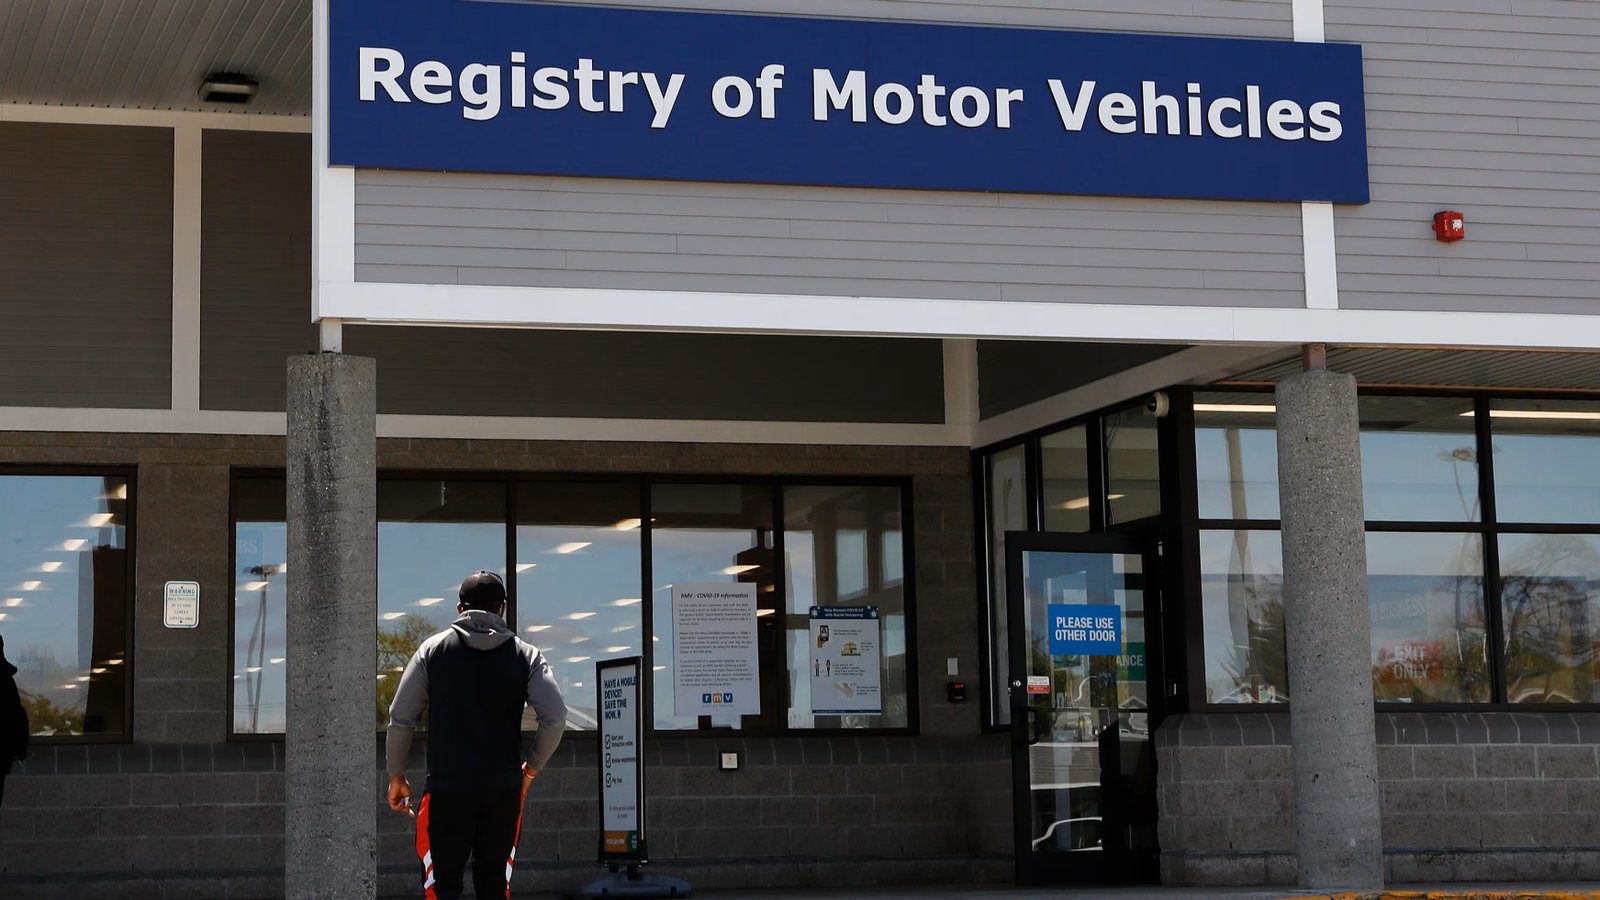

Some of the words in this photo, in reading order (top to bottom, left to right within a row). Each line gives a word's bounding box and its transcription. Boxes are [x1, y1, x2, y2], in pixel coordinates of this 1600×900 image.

[360, 47, 685, 128] Registry
[712, 65, 784, 118] of
[814, 69, 1023, 127] Motor
[1048, 79, 1342, 141] Vehicles
[720, 592, 749, 600] Information
[1056, 616, 1093, 629] PLEASE
[1095, 617, 1114, 629] USE
[1055, 629, 1087, 641] OTHER
[1089, 630, 1116, 642] DOOR
[1394, 645, 1426, 661] EXIT
[1393, 664, 1430, 680] ONLY
[604, 679, 616, 689] HAVE
[616, 678, 621, 687] A
[604, 689, 623, 700] DEVICE?
[604, 700, 616, 710] SAVE
[616, 699, 627, 708] TIME
